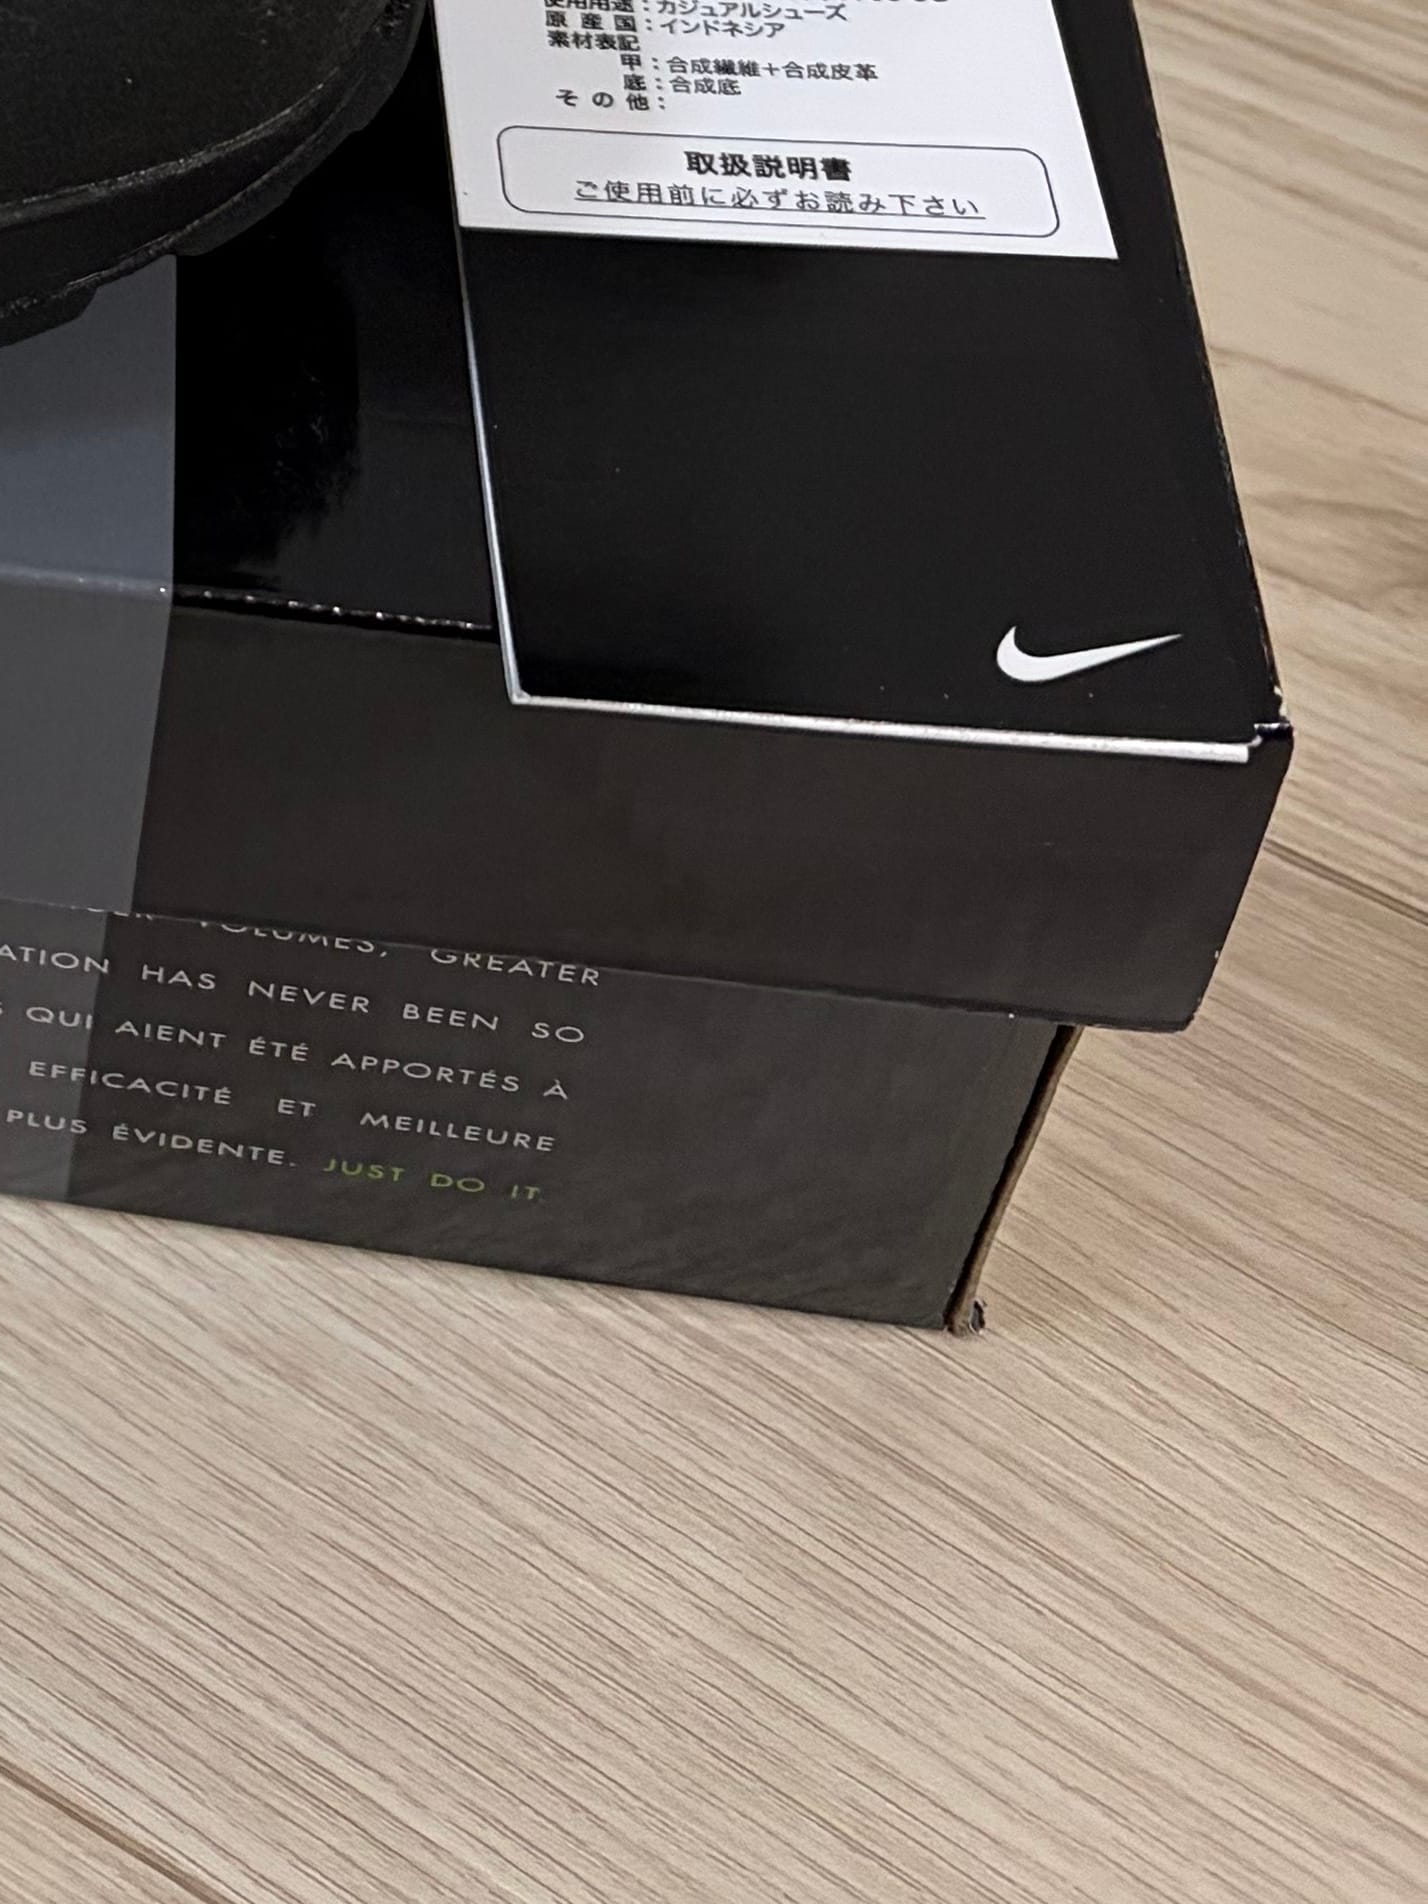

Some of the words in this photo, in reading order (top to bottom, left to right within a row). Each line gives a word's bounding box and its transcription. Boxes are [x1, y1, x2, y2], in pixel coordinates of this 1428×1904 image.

[548, 30, 641, 51] 素材表記
[660, 18, 785, 38] インドネシア
[669, 76, 742, 95] 合成底
[684, 149, 852, 182] 取扱説明書
[575, 179, 980, 217] ご使用前に必ずお読み下さい
[430, 947, 600, 987] GREATER
[141, 963, 217, 991] HAS
[247, 980, 370, 1014] NEVER
[402, 1002, 499, 1032] BEEN
[530, 1021, 585, 1044] SO
[25, 1006, 94, 1032] QUI
[114, 1020, 227, 1049] AIENT
[248, 1035, 310, 1062] ÉTÉ
[330, 1052, 520, 1093] APPORTÉS
[542, 1078, 569, 1101] À
[28, 1060, 232, 1105] EFFICACITÉ
[277, 1097, 317, 1118] ET
[359, 1111, 556, 1152] MEILLEURE
[5, 1108, 88, 1135] PLUS
[322, 1158, 406, 1182] JUST
[430, 1172, 486, 1193] DO
